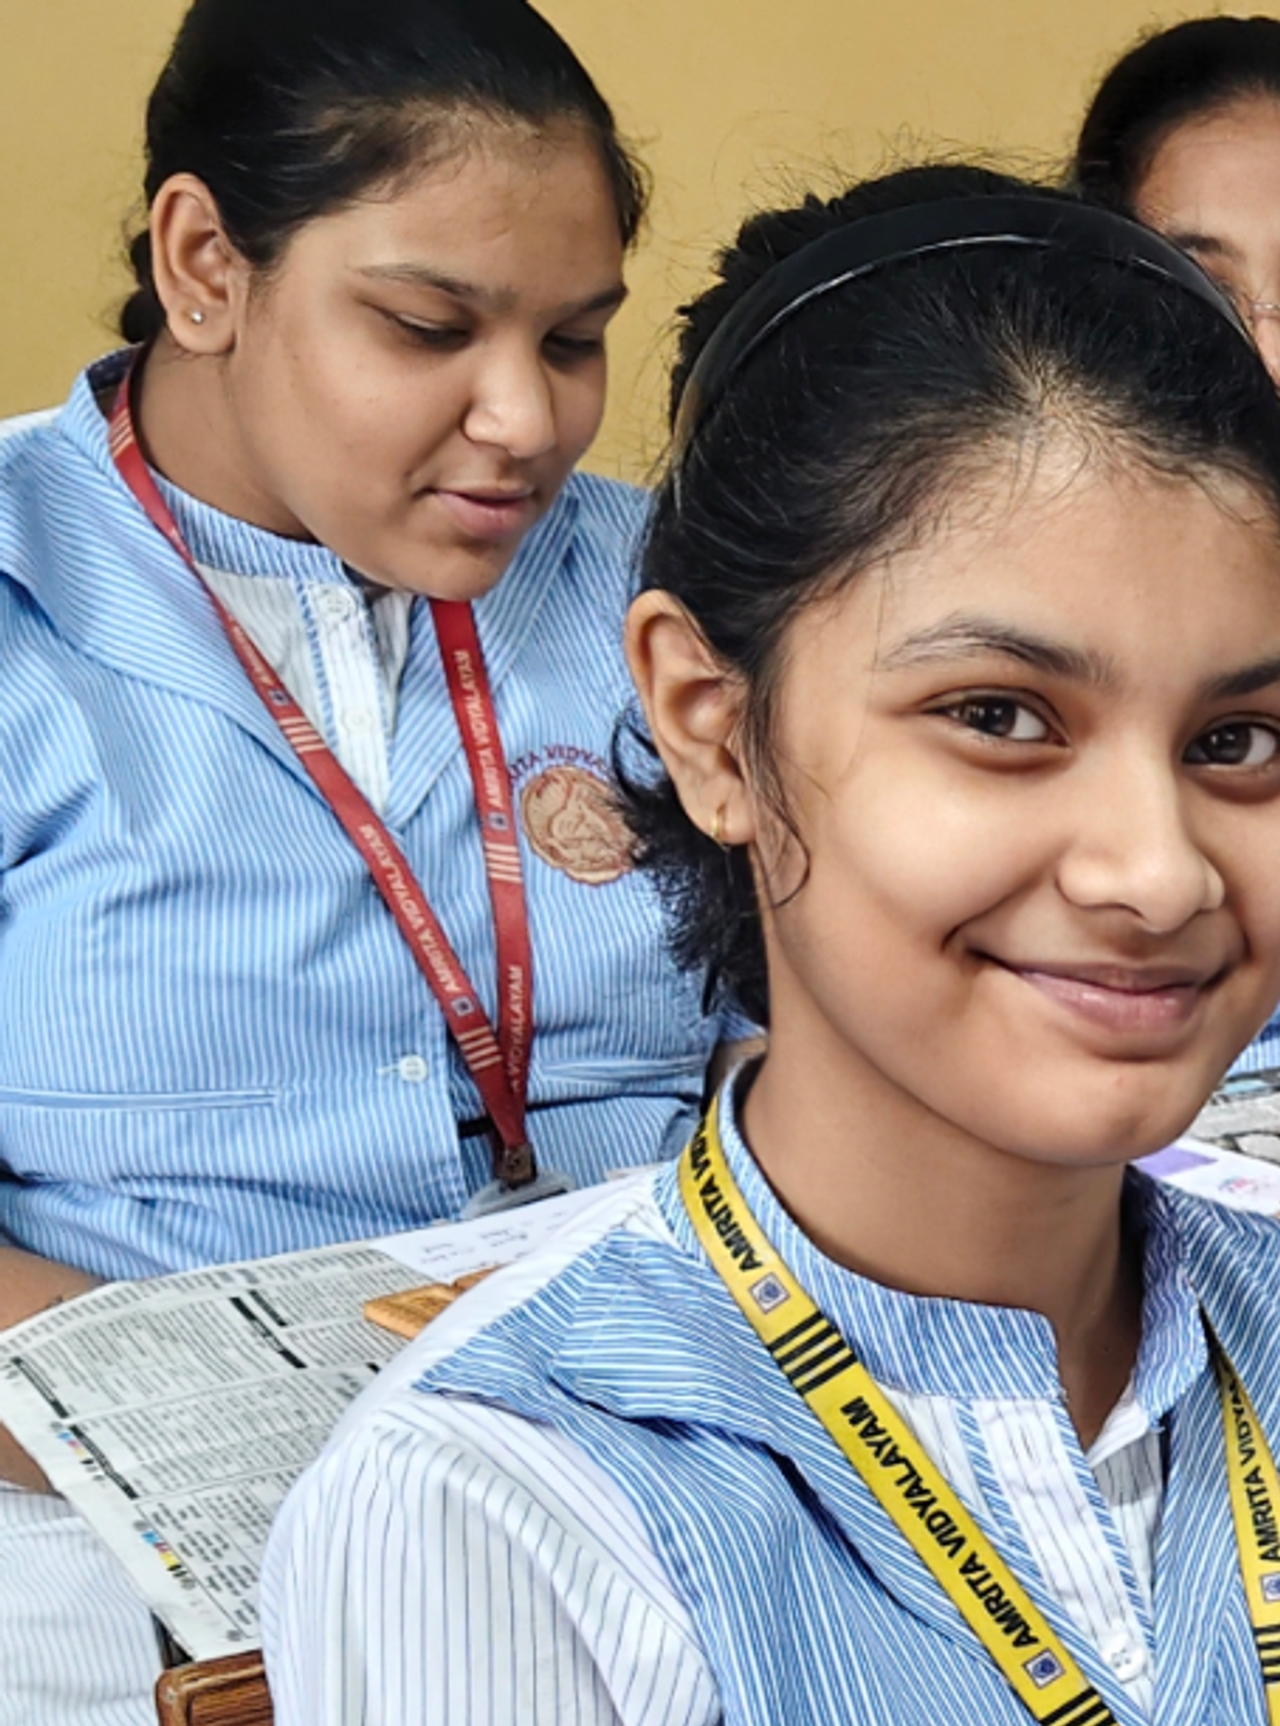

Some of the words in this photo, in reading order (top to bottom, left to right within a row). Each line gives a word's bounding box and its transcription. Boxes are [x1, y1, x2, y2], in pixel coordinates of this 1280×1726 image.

[453, 649, 494, 748] VIDYALAYAM
[474, 744, 507, 813] AMRITA
[354, 822, 427, 932] VIDYALAYAM
[416, 926, 464, 995] AMRITA
[692, 1165, 765, 1274] AMRITA
[838, 1394, 968, 1561] VIDYALAYAM
[949, 1547, 1046, 1658] AMRITA
